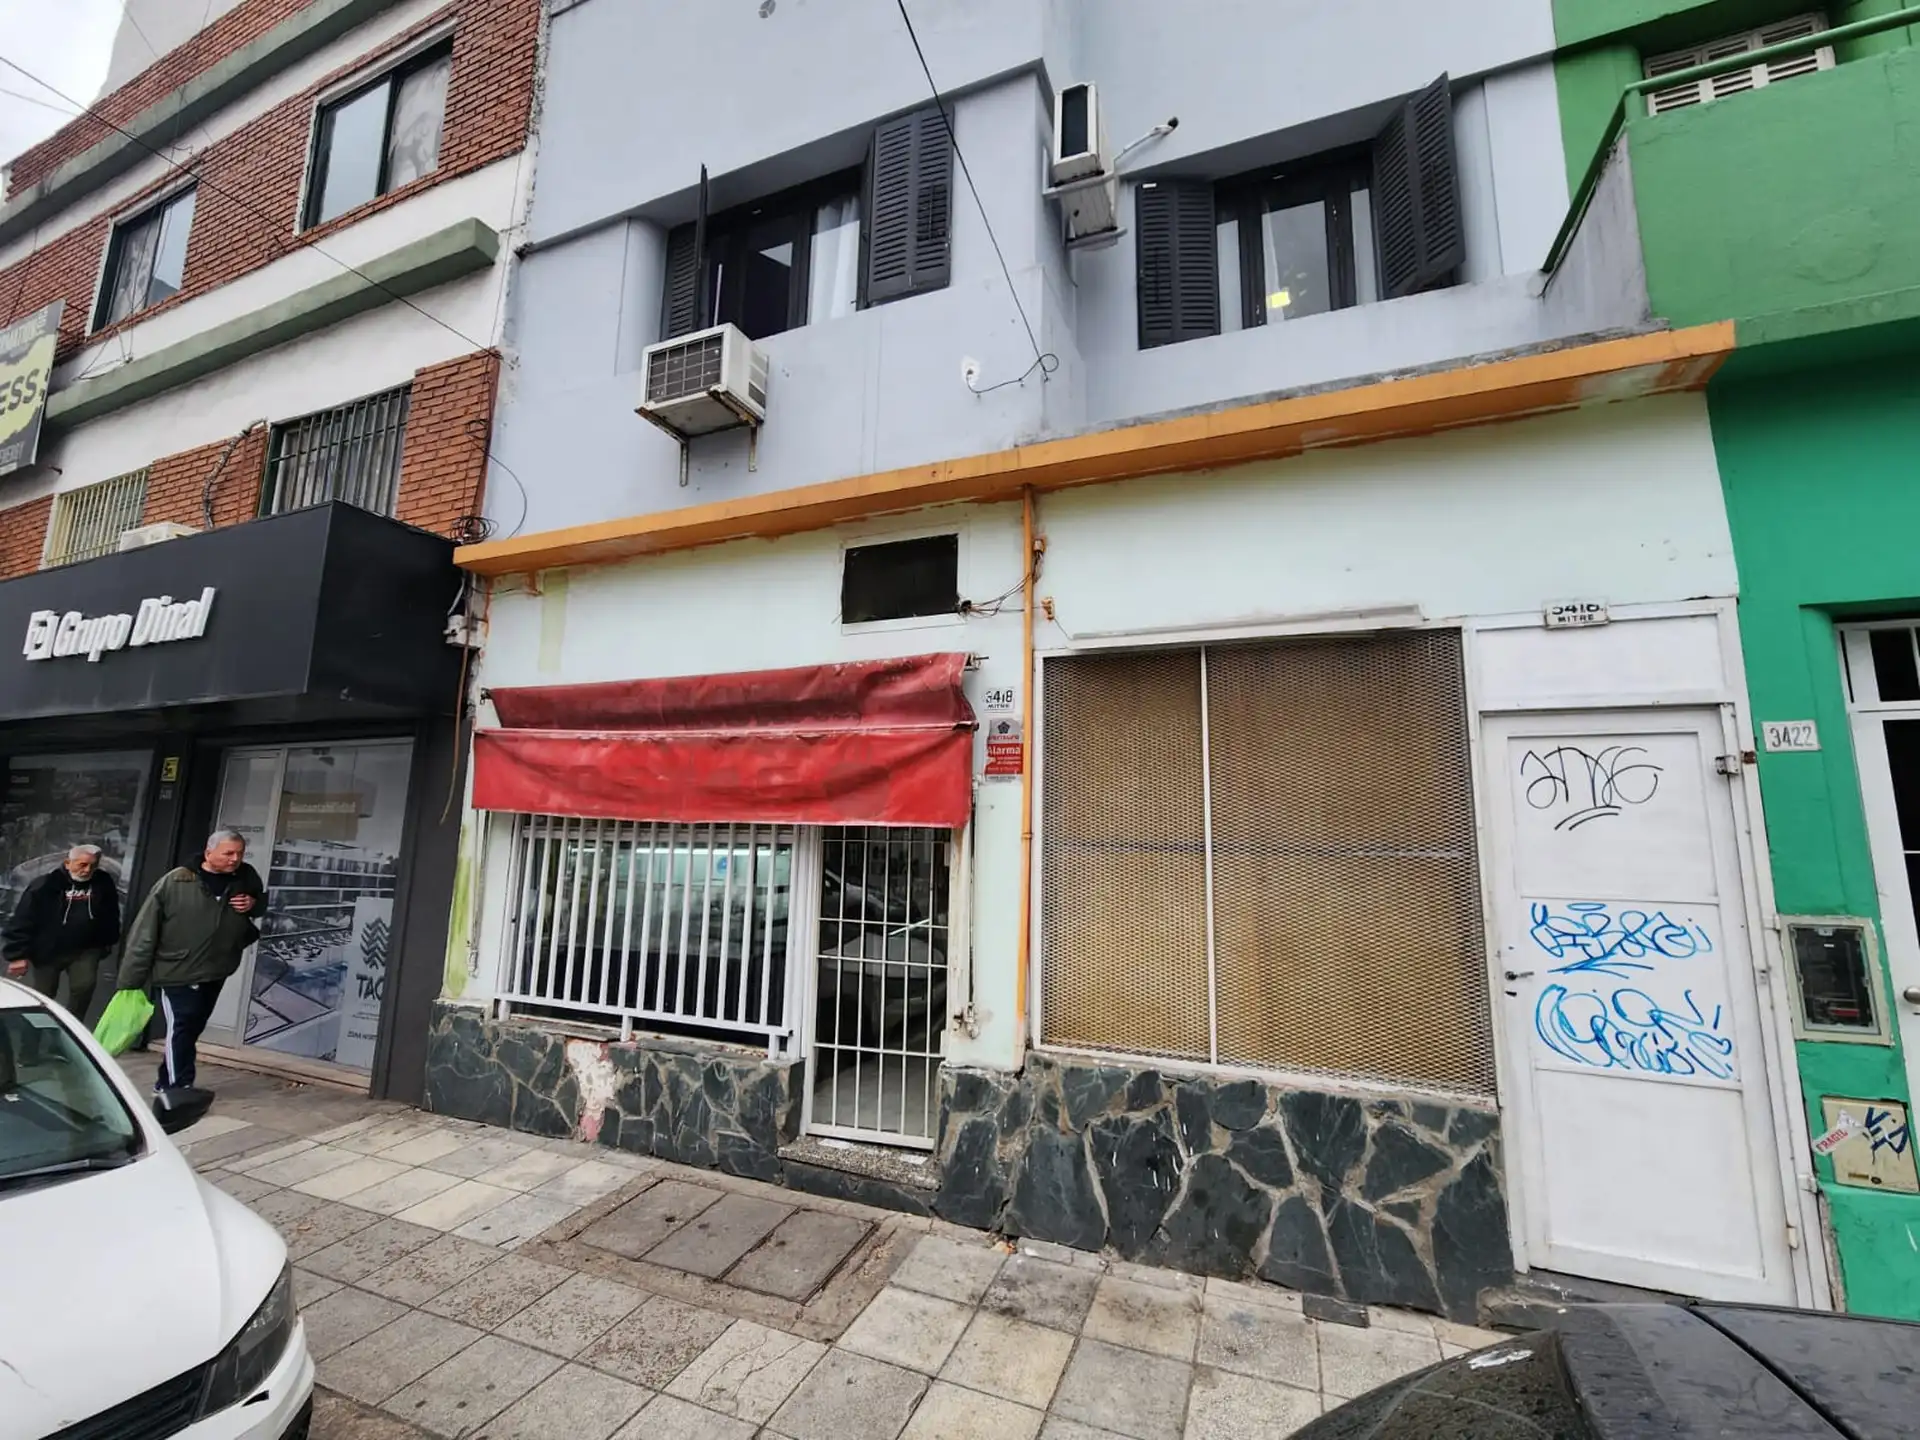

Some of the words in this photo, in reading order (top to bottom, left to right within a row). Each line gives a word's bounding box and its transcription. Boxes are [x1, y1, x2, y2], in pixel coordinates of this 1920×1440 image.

[23, 610, 60, 660] El
[53, 611, 133, 662] Grupo
[129, 587, 215, 646] Dinal
[1557, 613, 1594, 622] MITRE
[1769, 726, 1813, 748] 3422
